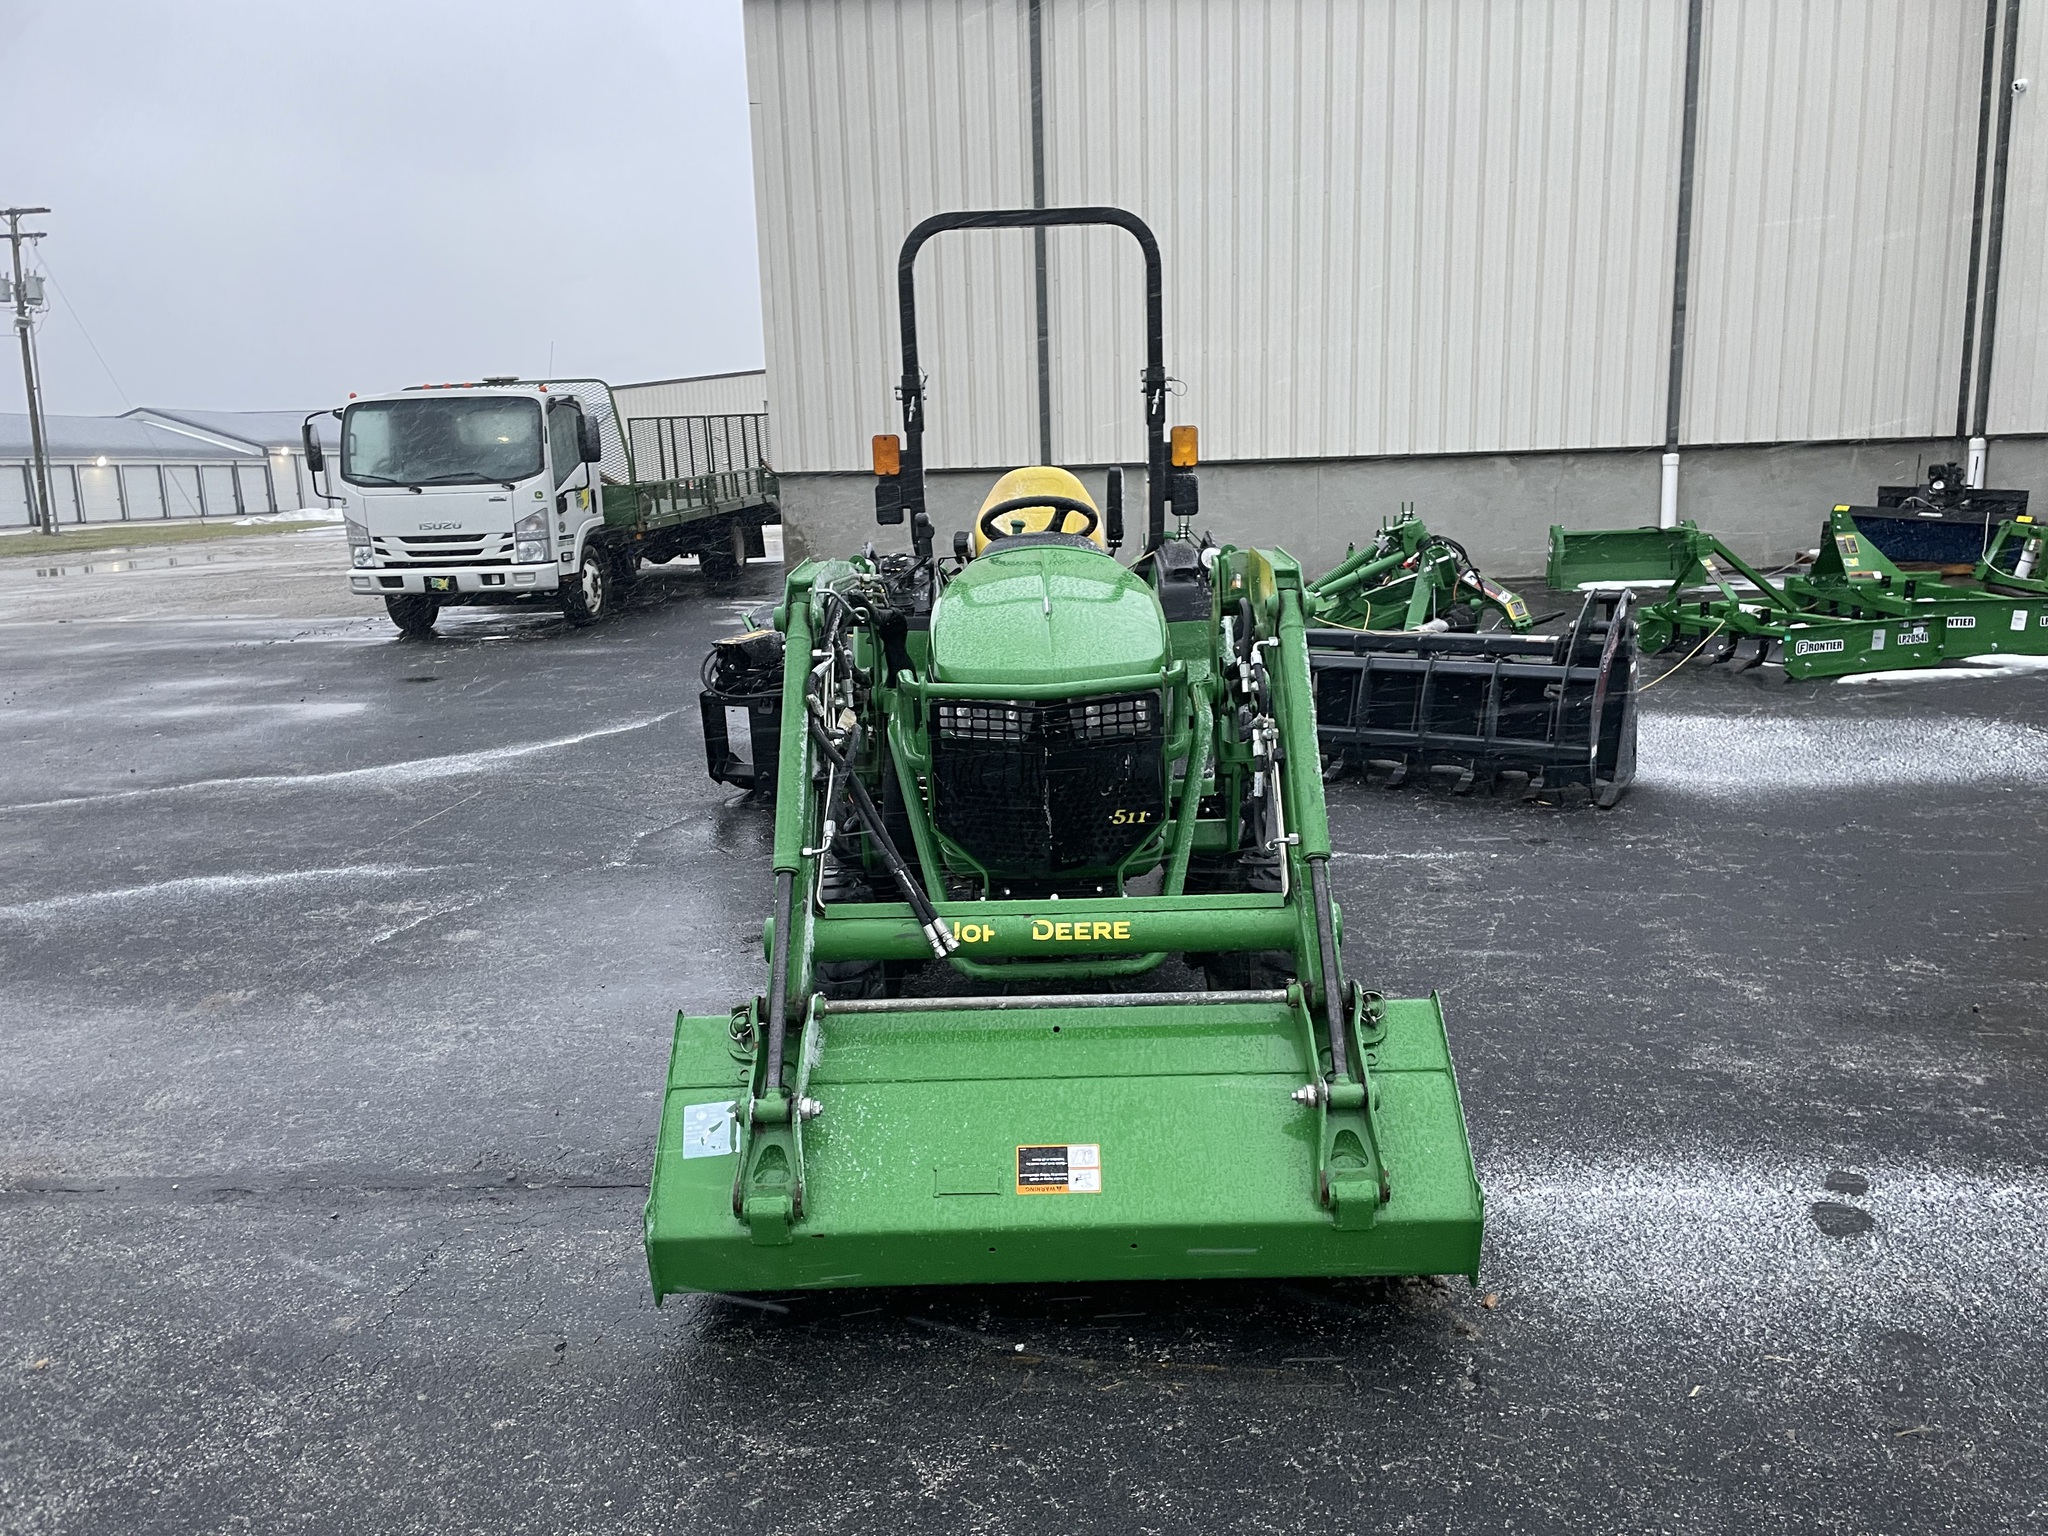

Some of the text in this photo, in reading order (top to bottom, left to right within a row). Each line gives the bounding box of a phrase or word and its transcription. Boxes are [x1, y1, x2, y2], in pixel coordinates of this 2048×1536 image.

[418, 521, 462, 531] ISUZU
[1947, 617, 1974, 627] NTIER
[1797, 640, 1843, 654] FRONTIER
[1031, 919, 1131, 941] DEERE
